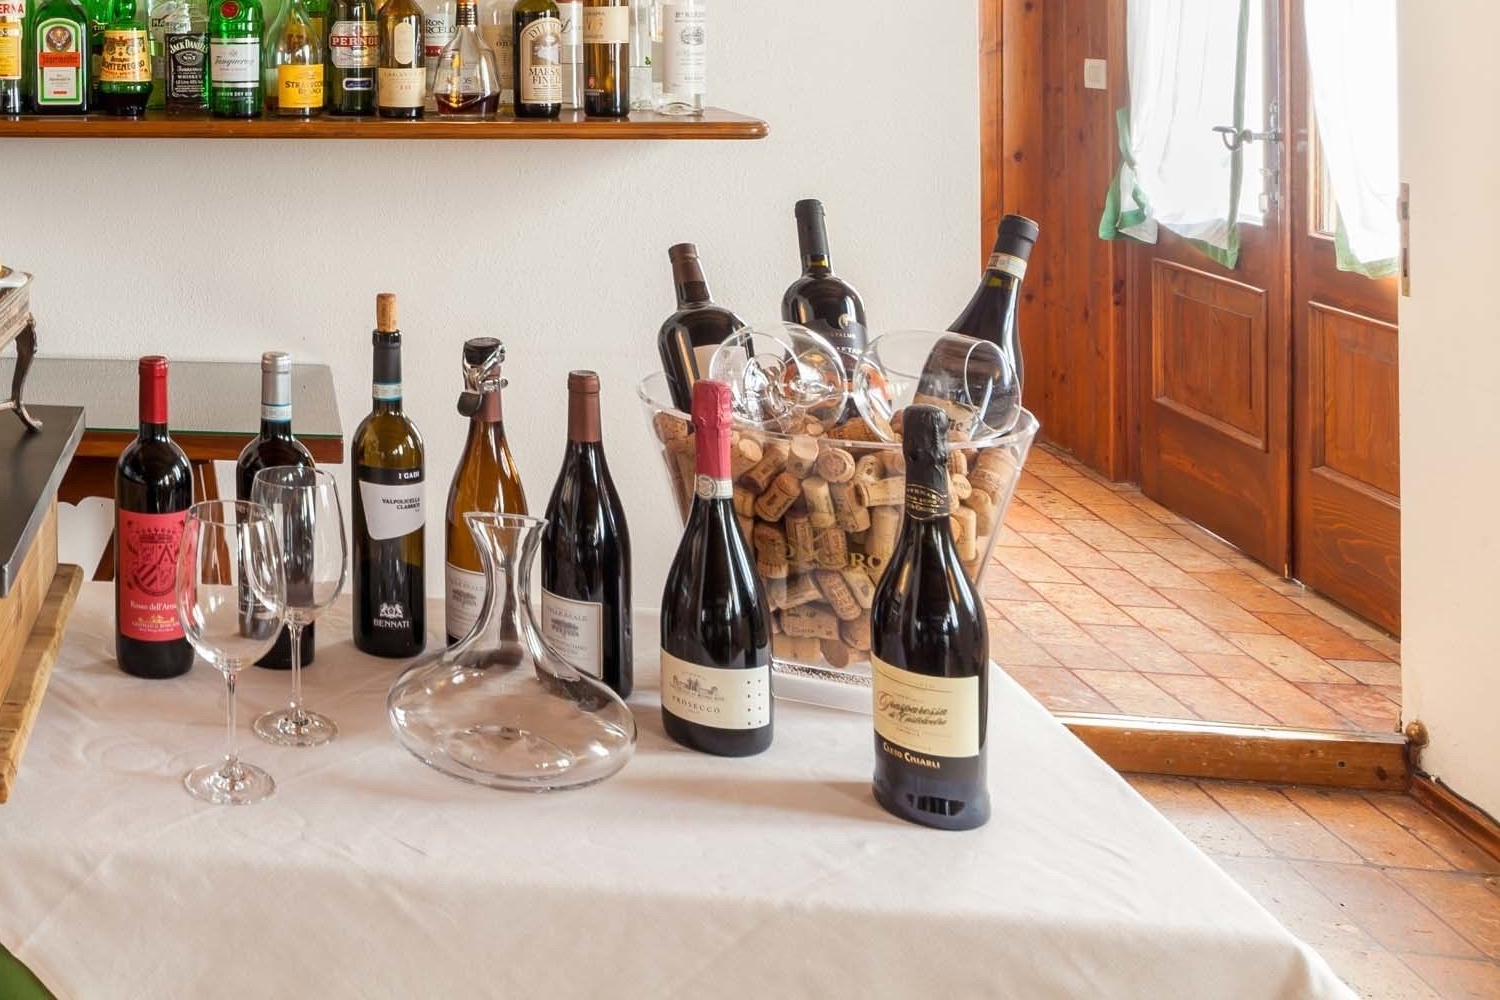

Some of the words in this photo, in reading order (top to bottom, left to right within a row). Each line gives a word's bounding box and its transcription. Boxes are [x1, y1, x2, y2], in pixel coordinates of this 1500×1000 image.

[373, 618, 411, 629] BENNATI
[672, 695, 721, 713] PROSECCO
[904, 752, 941, 769] CHIARLI
